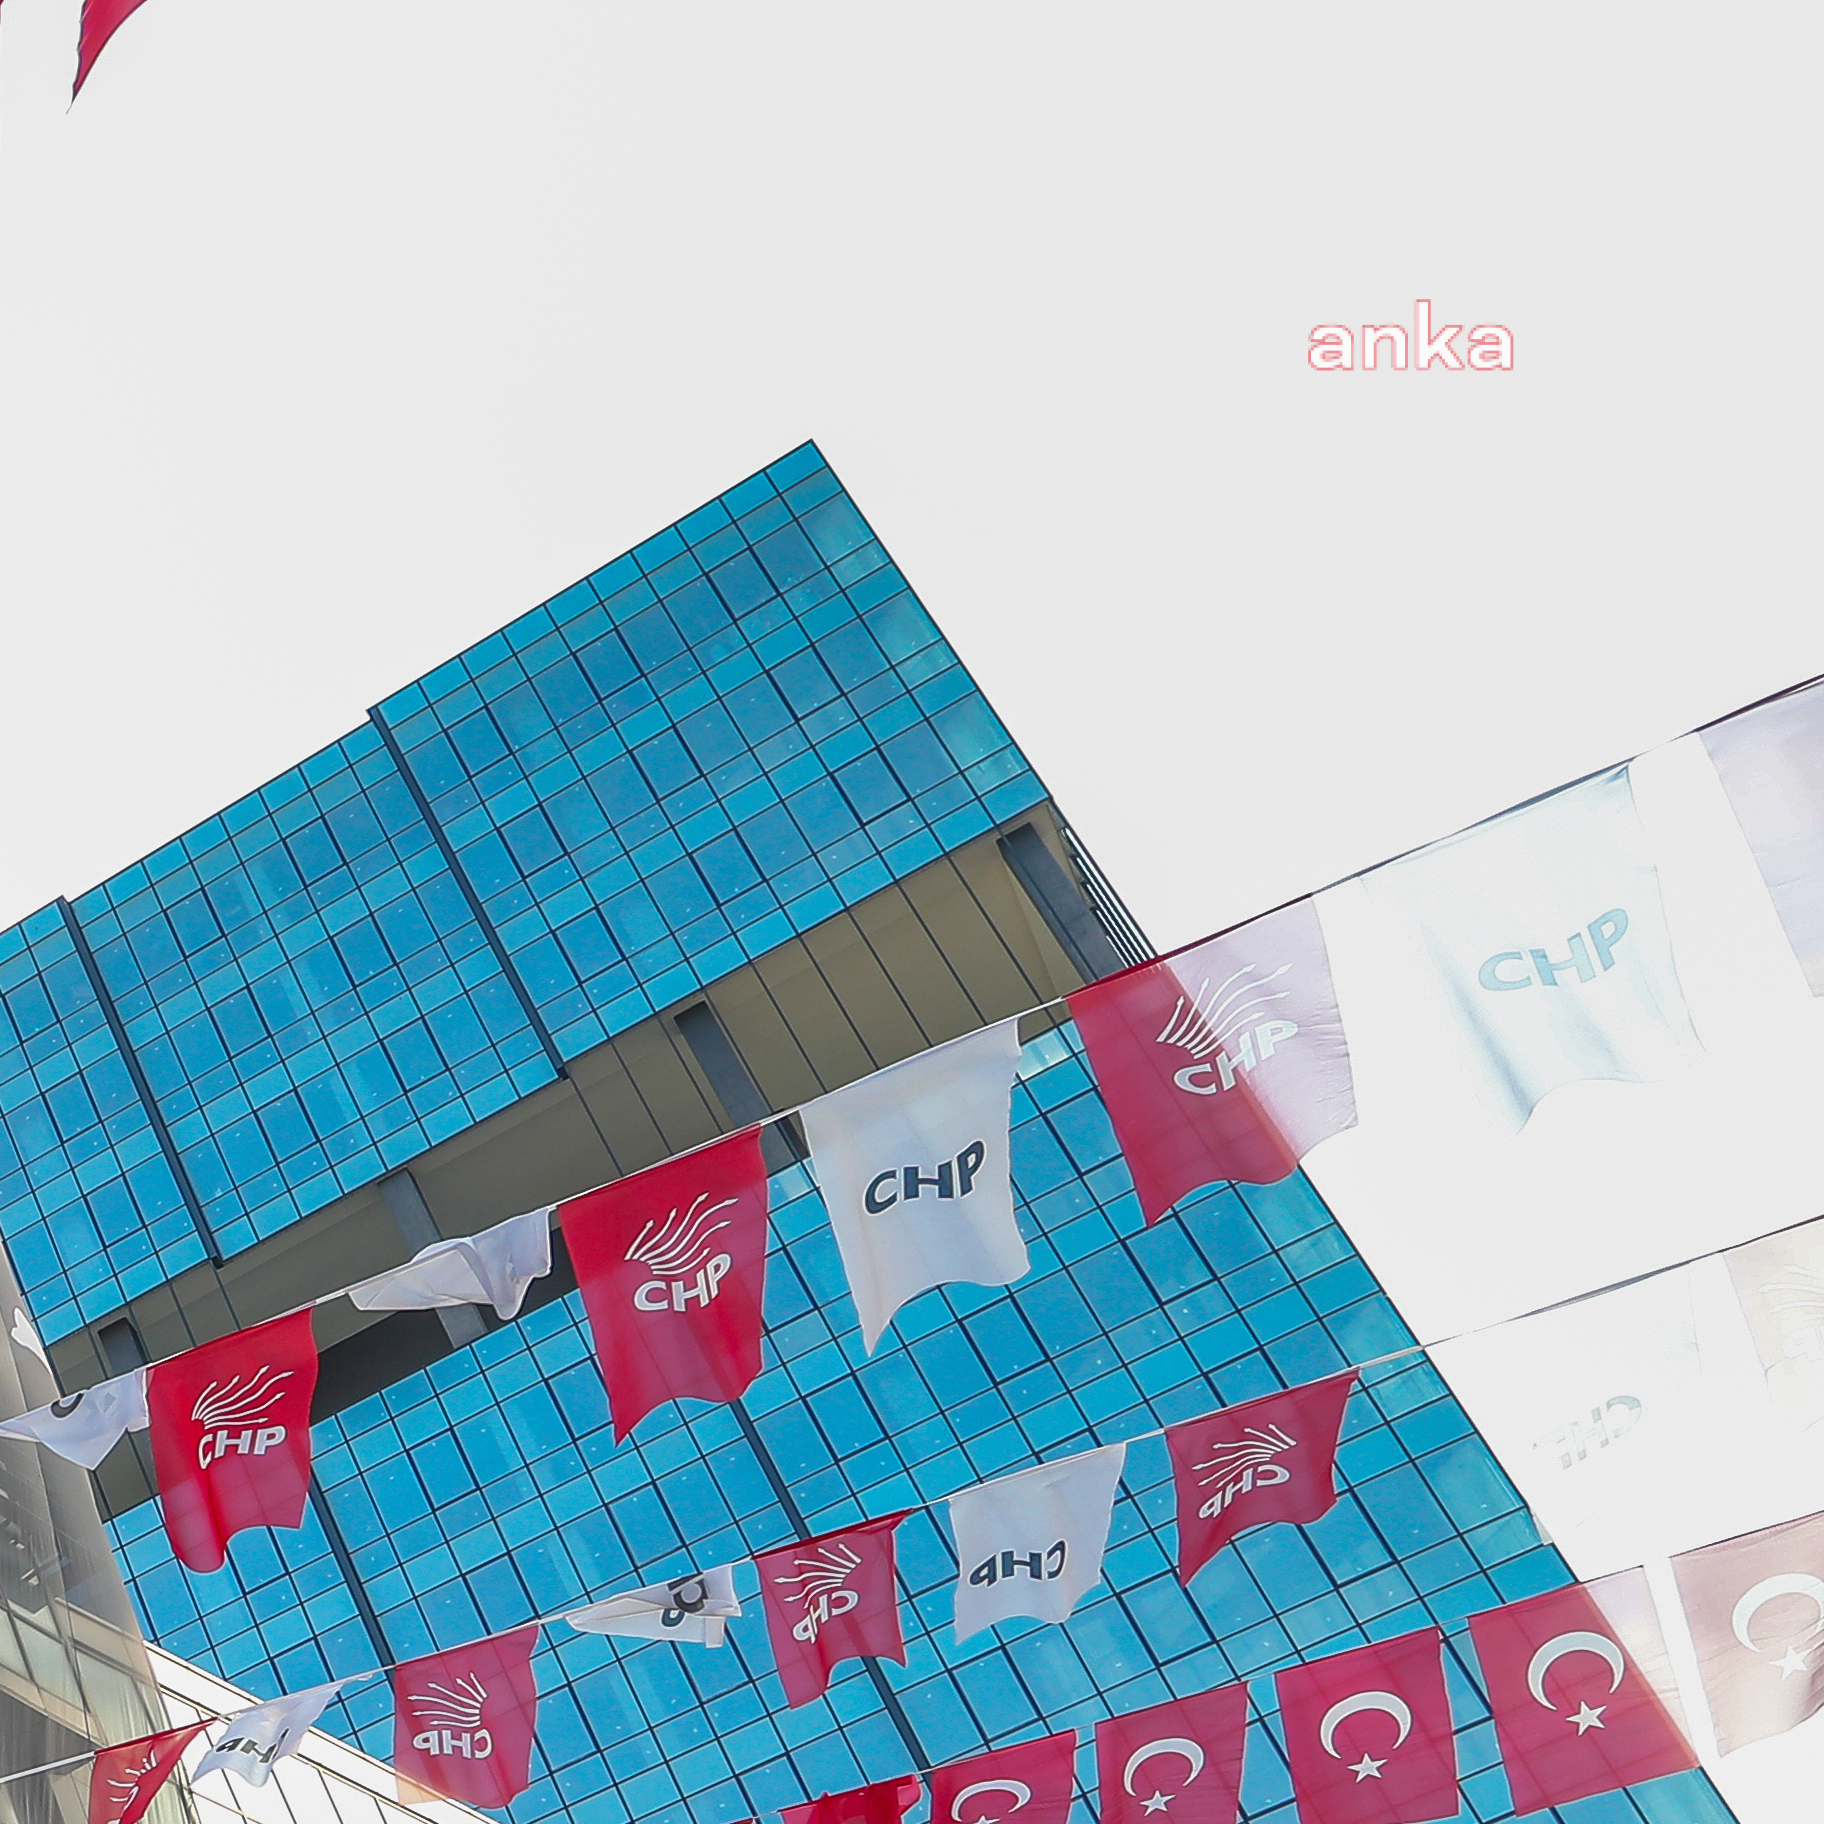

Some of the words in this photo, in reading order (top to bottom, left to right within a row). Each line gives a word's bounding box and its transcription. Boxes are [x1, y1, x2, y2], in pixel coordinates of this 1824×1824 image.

[1477, 906, 1631, 993] CHP
[1172, 1016, 1299, 1098] CHP
[863, 1139, 986, 1216] CHP
[632, 1252, 733, 1313] CHP
[197, 1425, 286, 1470] CHP
